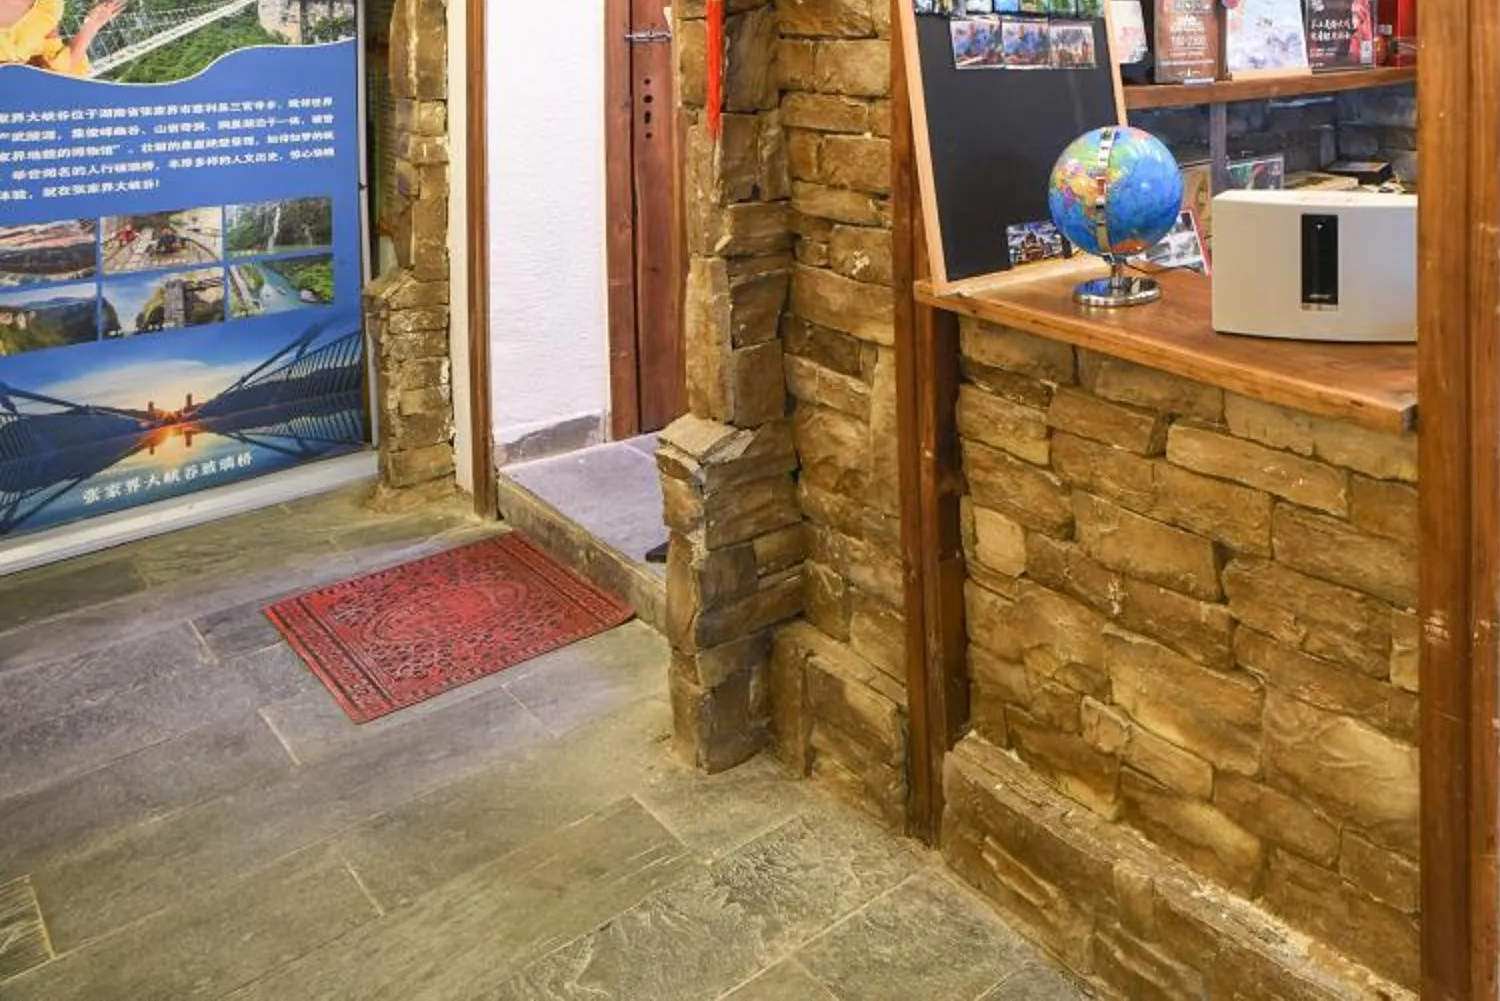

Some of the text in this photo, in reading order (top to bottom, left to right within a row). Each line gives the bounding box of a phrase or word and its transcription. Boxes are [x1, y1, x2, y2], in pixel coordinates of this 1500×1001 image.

[83, 452, 253, 504] 张家界大峡谷玻璃桥
